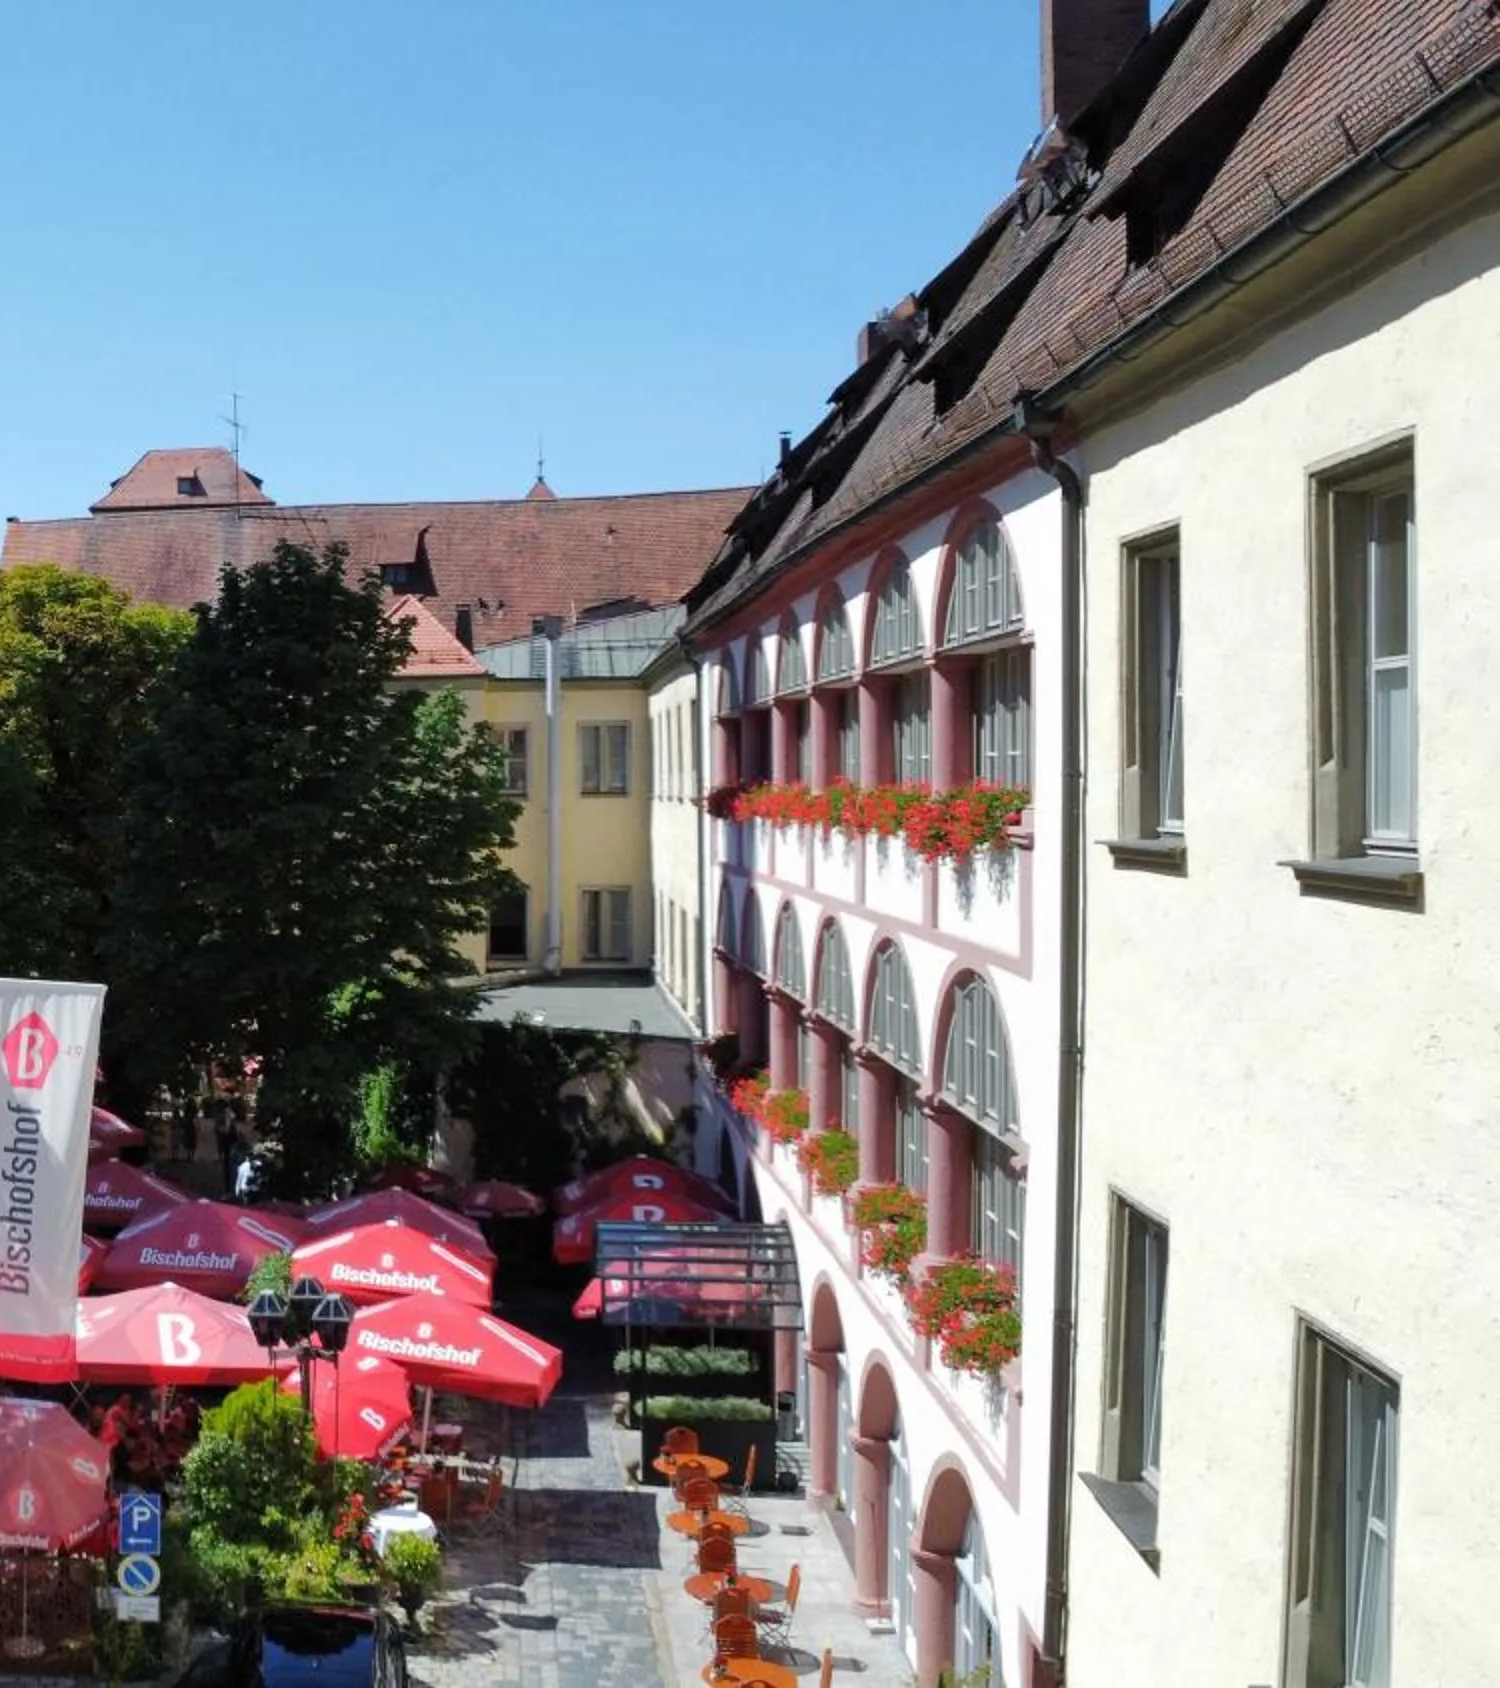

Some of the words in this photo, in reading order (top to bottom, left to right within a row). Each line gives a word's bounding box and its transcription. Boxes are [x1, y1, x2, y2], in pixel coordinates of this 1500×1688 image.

[17, 1027, 45, 1080] B
[139, 1247, 240, 1271] Bischofshof
[331, 1263, 439, 1292] Bischofshof
[156, 1312, 202, 1366] B
[357, 1329, 485, 1366] Bischofshof
[132, 1505, 152, 1532] P
